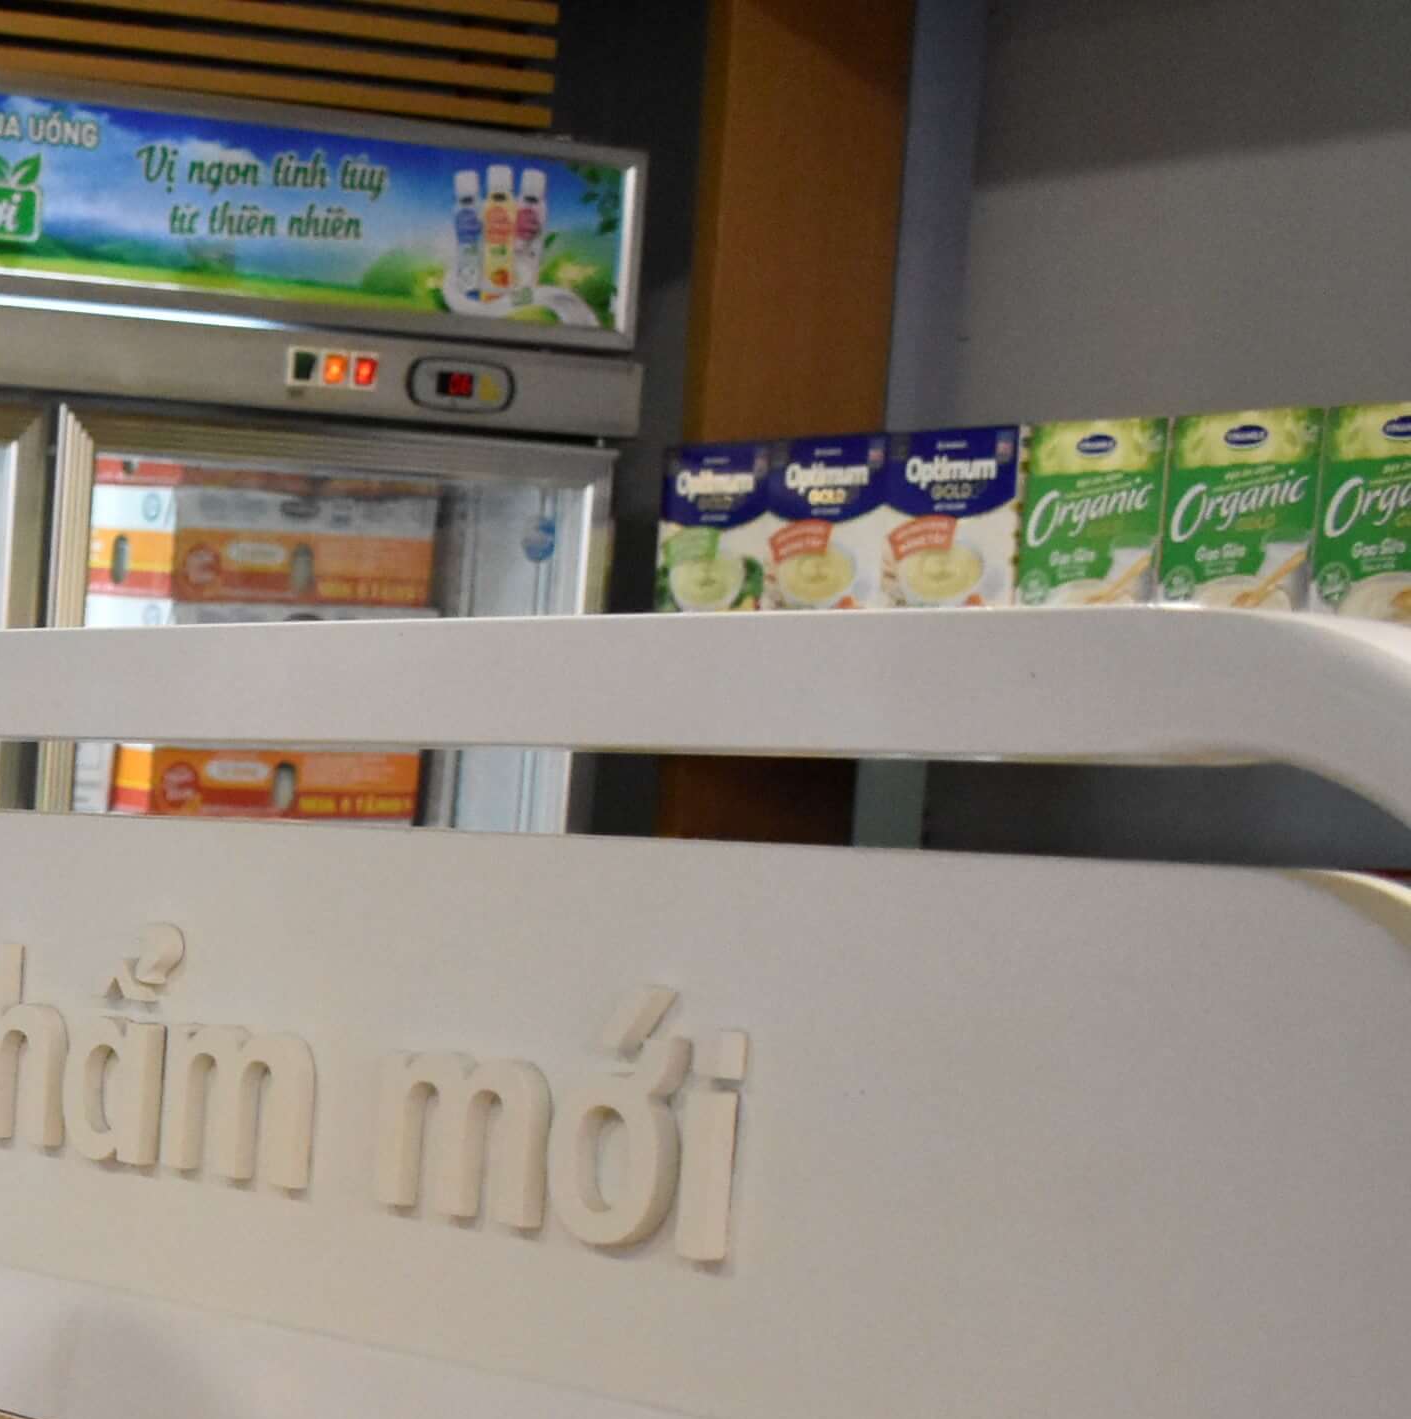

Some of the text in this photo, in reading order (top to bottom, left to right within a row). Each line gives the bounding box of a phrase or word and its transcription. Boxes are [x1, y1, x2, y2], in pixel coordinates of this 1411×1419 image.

[28, 110, 99, 148] UỐNG
[188, 156, 260, 193] ngon
[210, 202, 277, 238] thiên
[288, 206, 364, 240] nhiên
[1026, 476, 1154, 547] Organic
[1170, 469, 1309, 543] Organic
[389, 984, 751, 1264] mới
